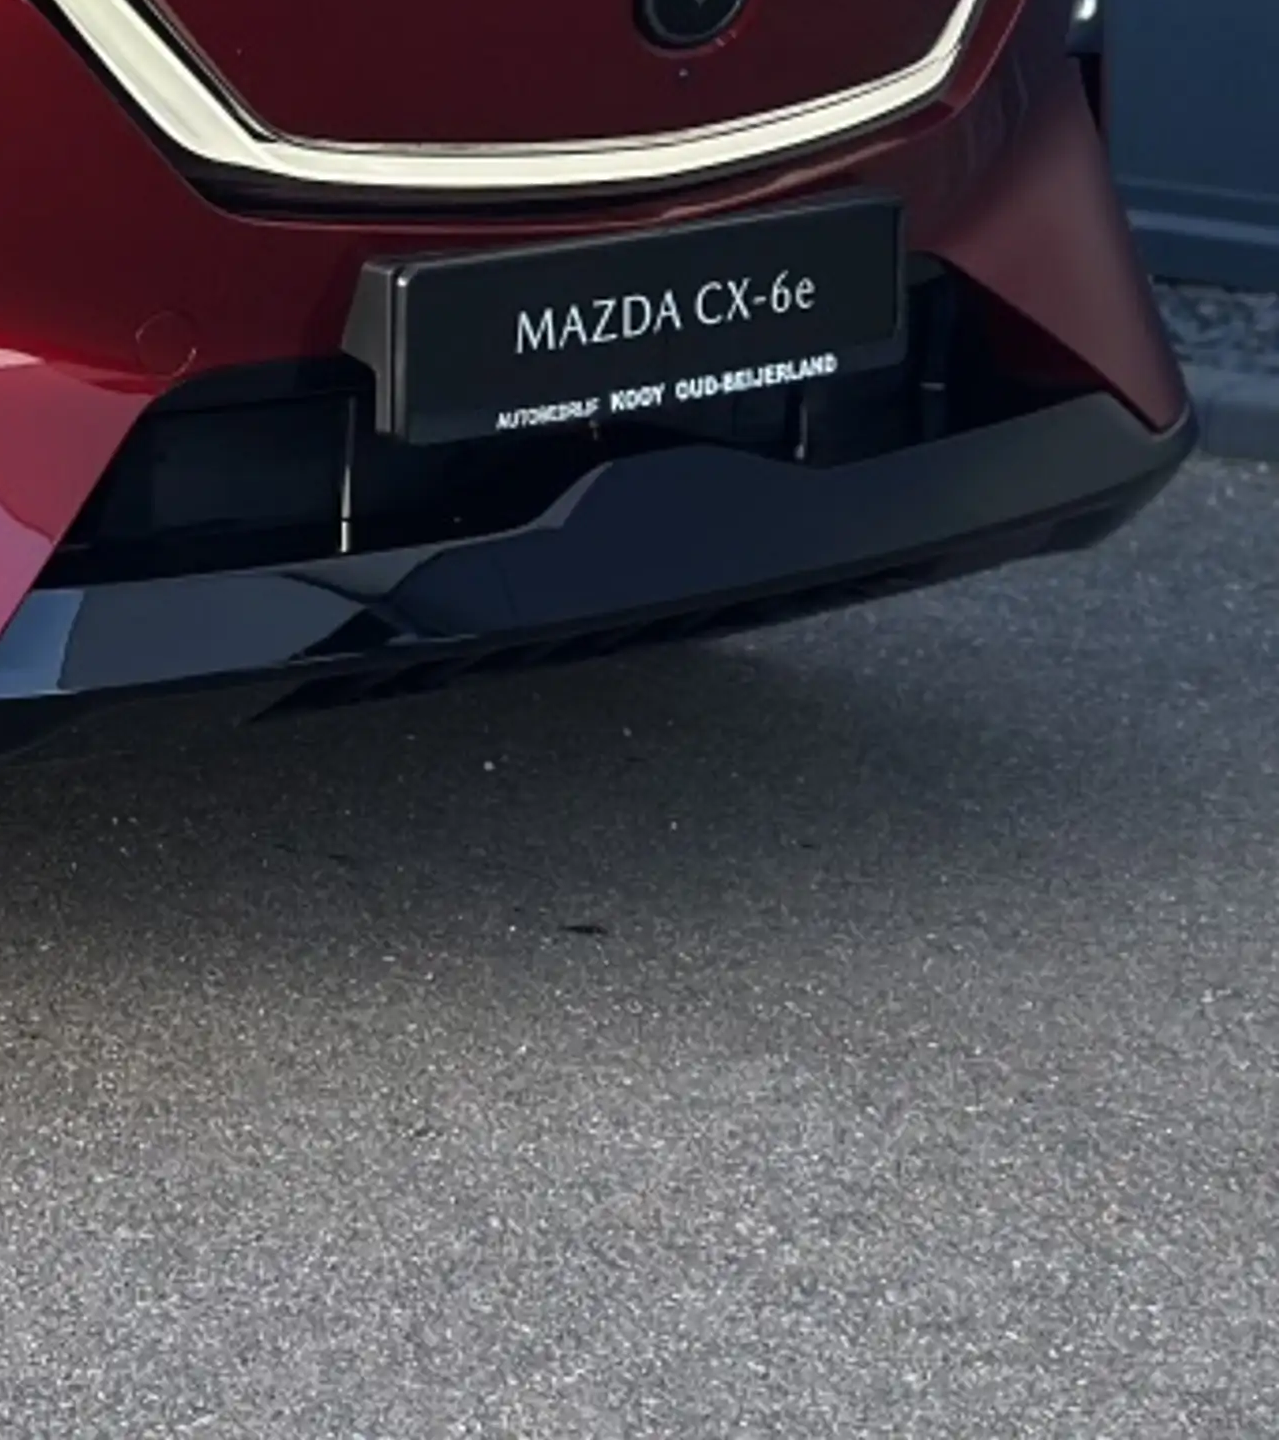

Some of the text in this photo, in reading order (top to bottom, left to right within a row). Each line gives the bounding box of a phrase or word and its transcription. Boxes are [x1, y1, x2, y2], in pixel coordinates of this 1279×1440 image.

[516, 270, 816, 354] MAZDA CX-6e
[609, 382, 666, 413] KOOY
[674, 352, 839, 402] OUD-BEIJERLAND
